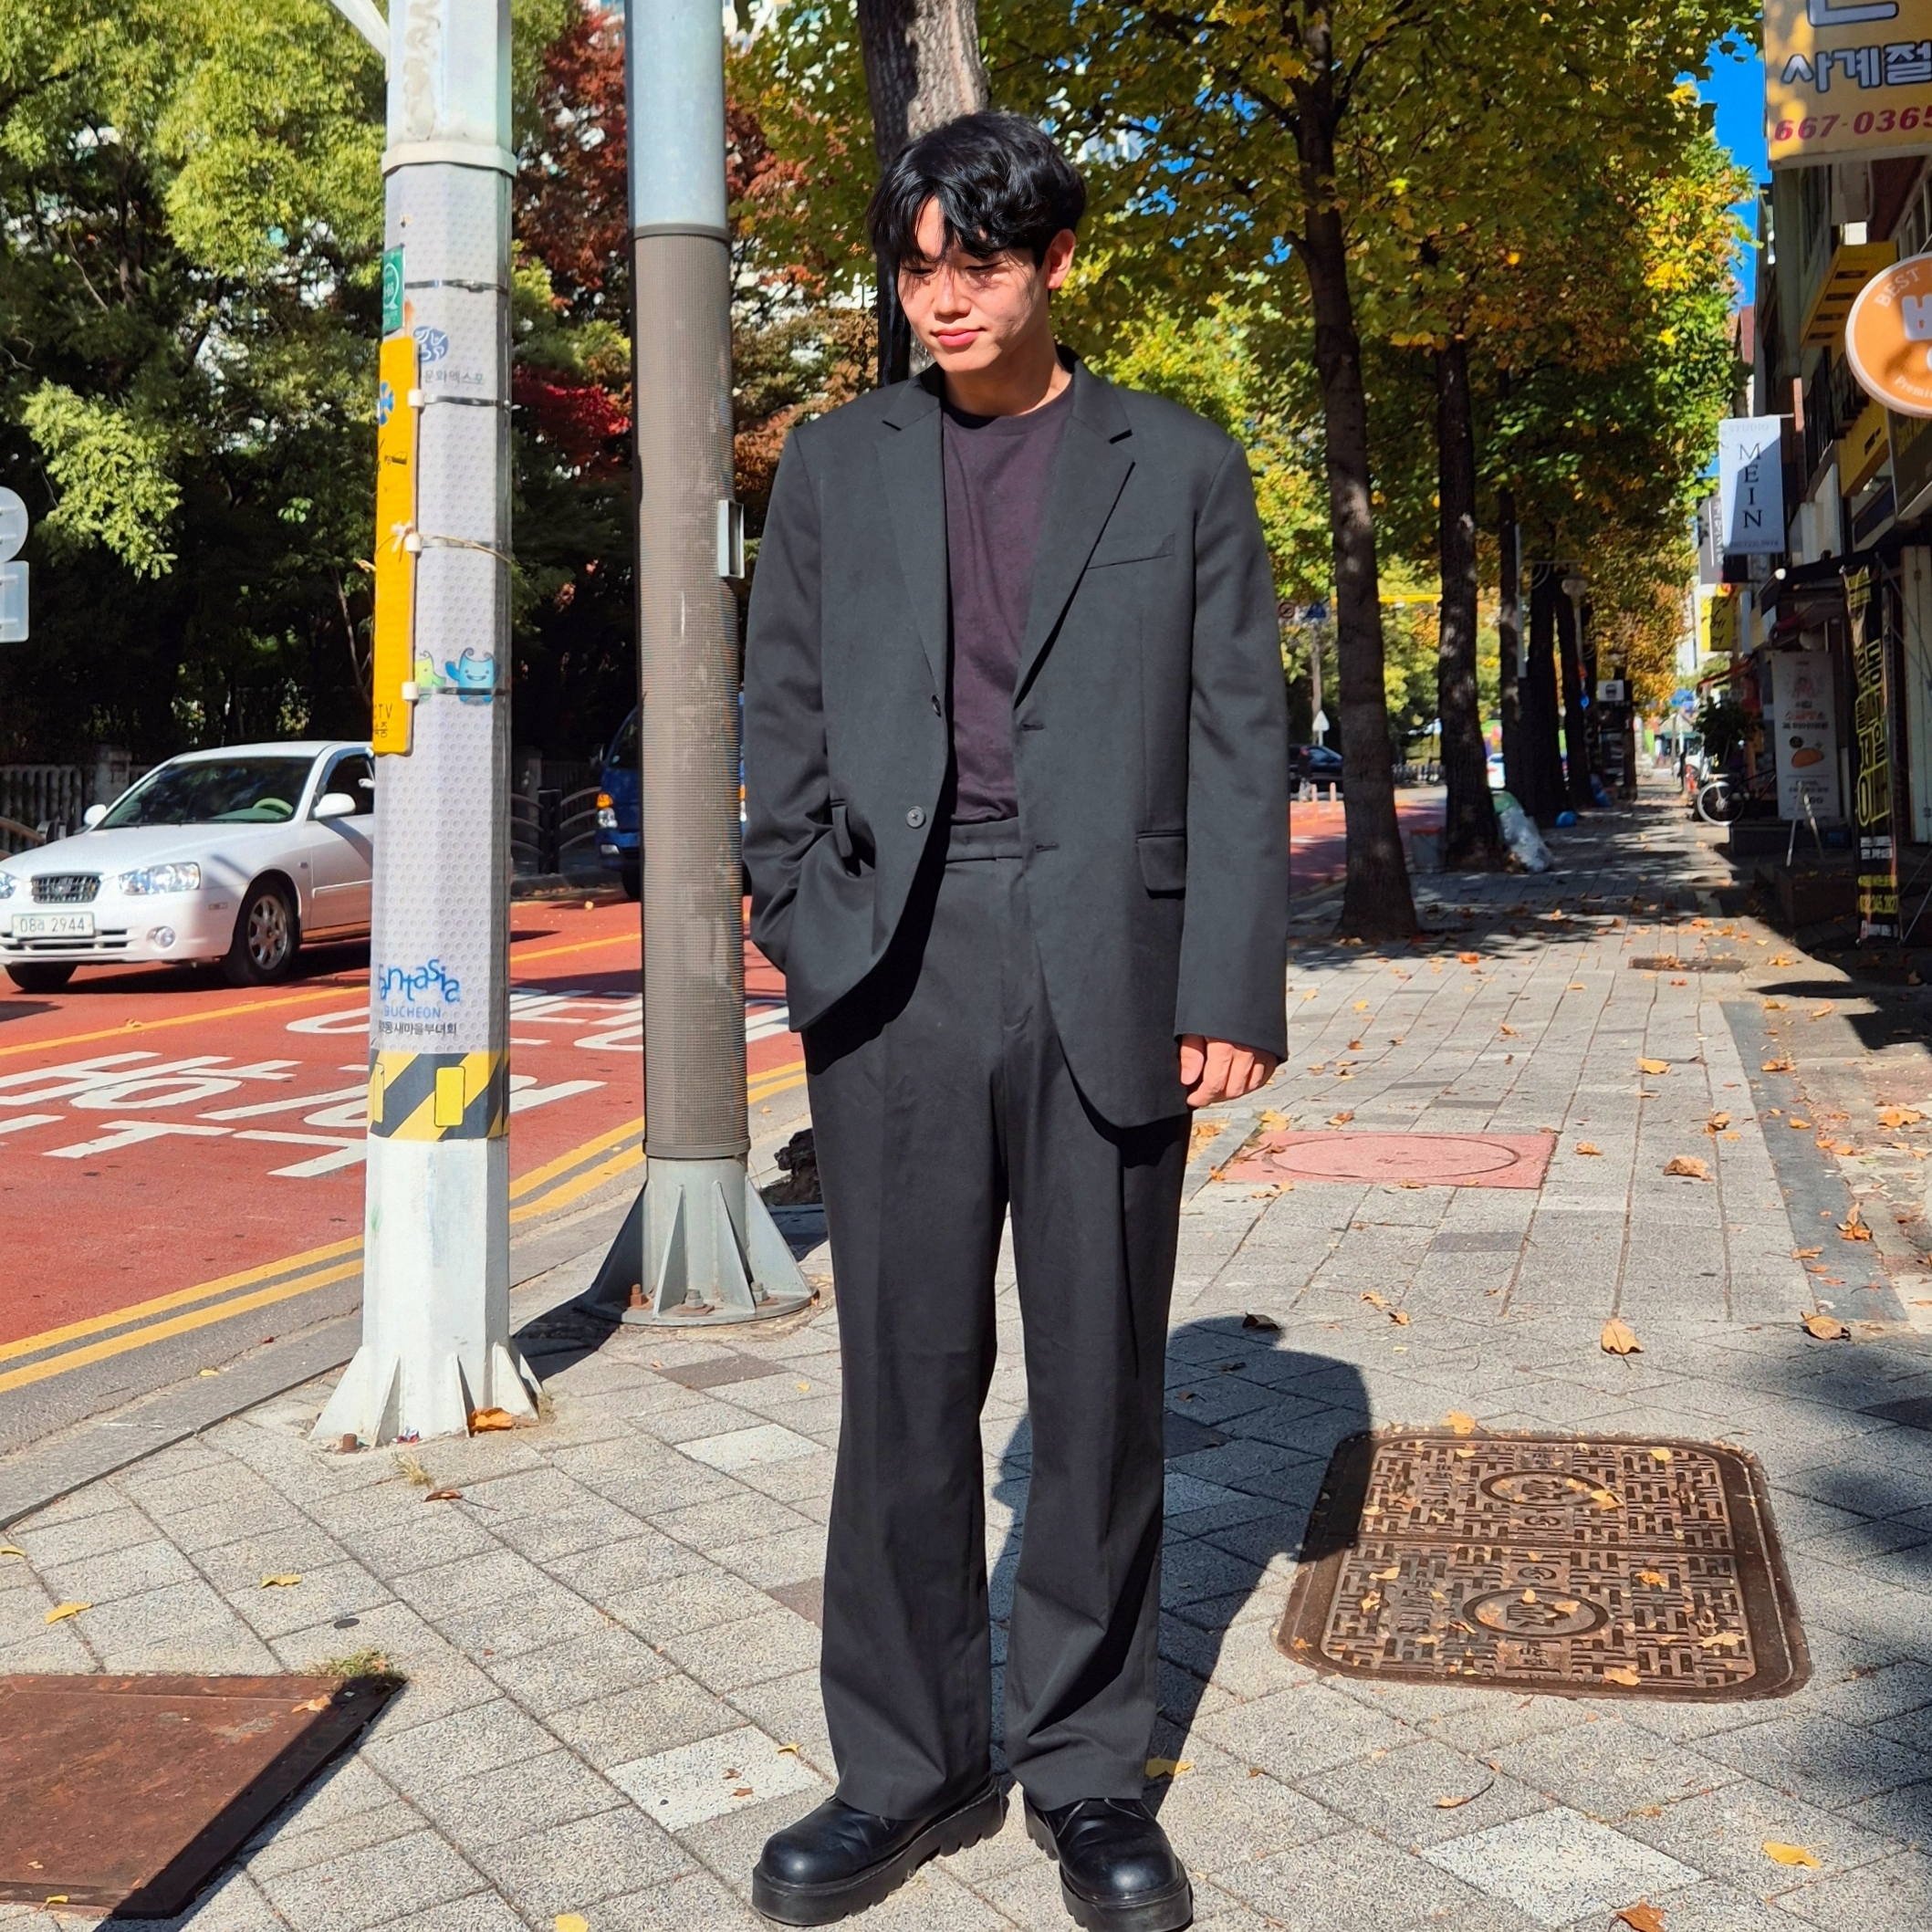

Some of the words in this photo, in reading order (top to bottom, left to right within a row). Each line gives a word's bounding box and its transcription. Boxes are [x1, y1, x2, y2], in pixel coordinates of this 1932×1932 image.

[1781, 39, 1932, 93] 사계절
[1875, 266, 1920, 308] BEST
[1739, 442, 1764, 529] MEIN
[51, 915, 85, 933] 2944
[383, 1004, 442, 1019] BUCHEON
